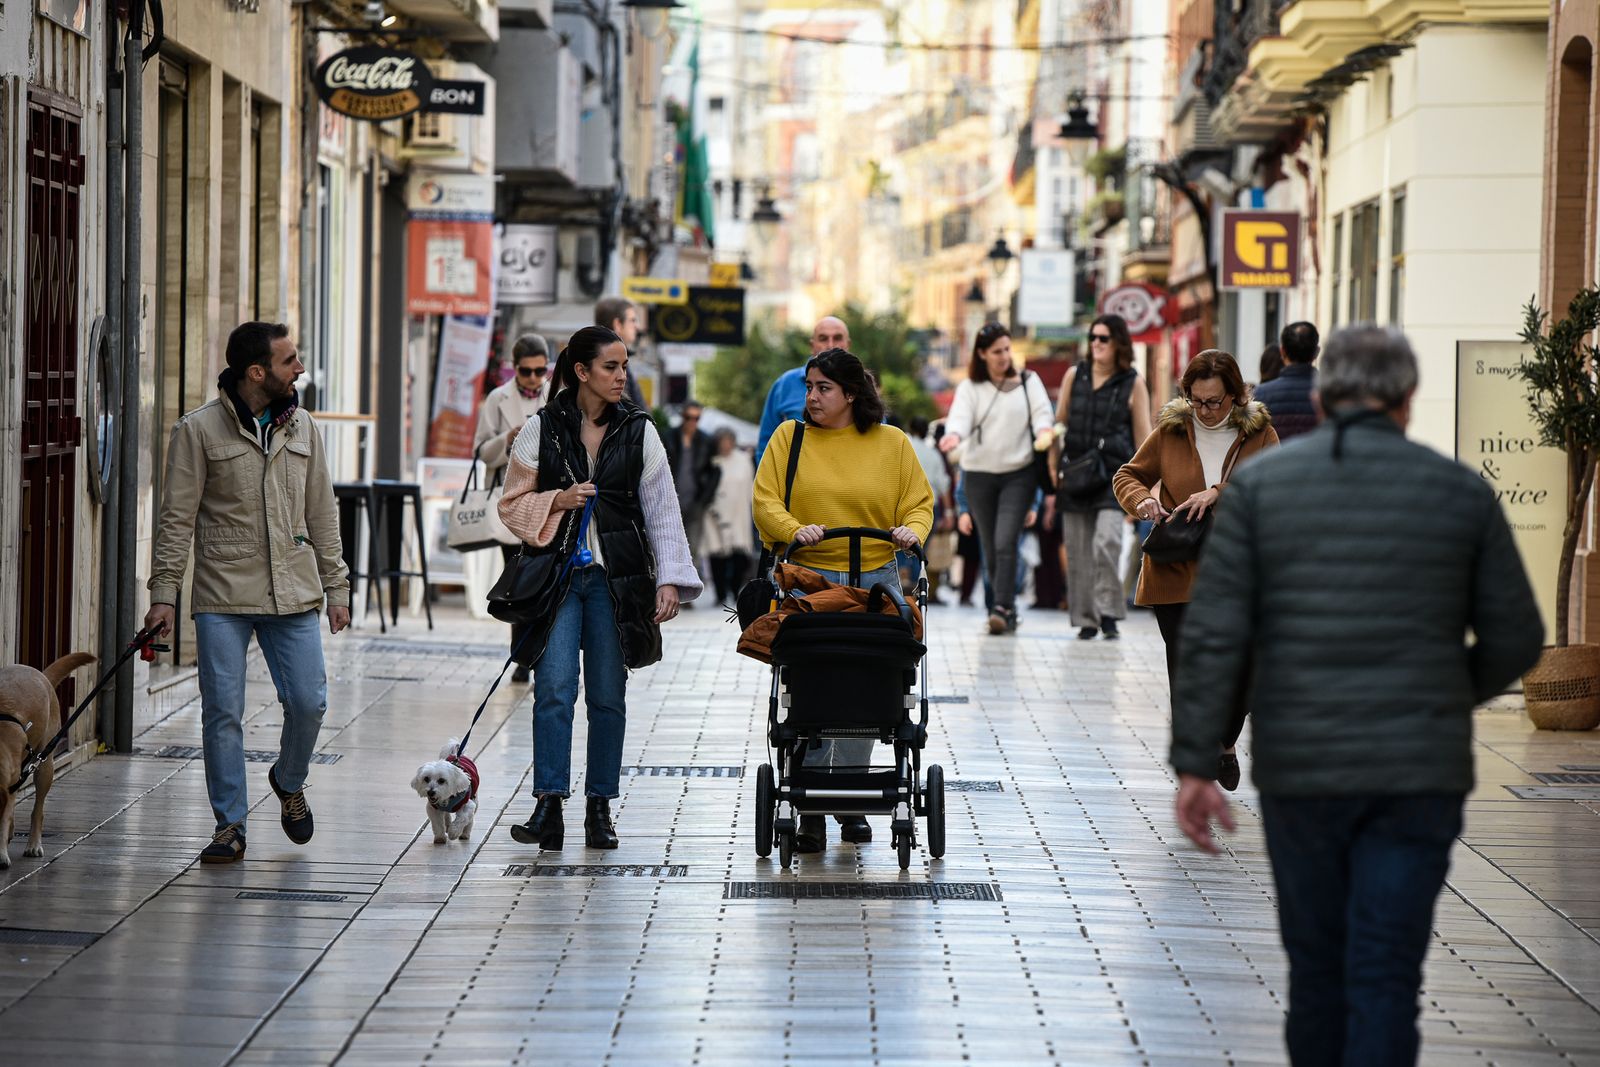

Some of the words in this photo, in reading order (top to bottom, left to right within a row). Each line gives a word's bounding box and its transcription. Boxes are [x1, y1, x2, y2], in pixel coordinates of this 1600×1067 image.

[430, 88, 475, 104] BON
[1231, 272, 1292, 287] TABACOS
[1480, 431, 1534, 454] nice
[1480, 458, 1501, 480] &
[1490, 482, 1548, 505] rice
